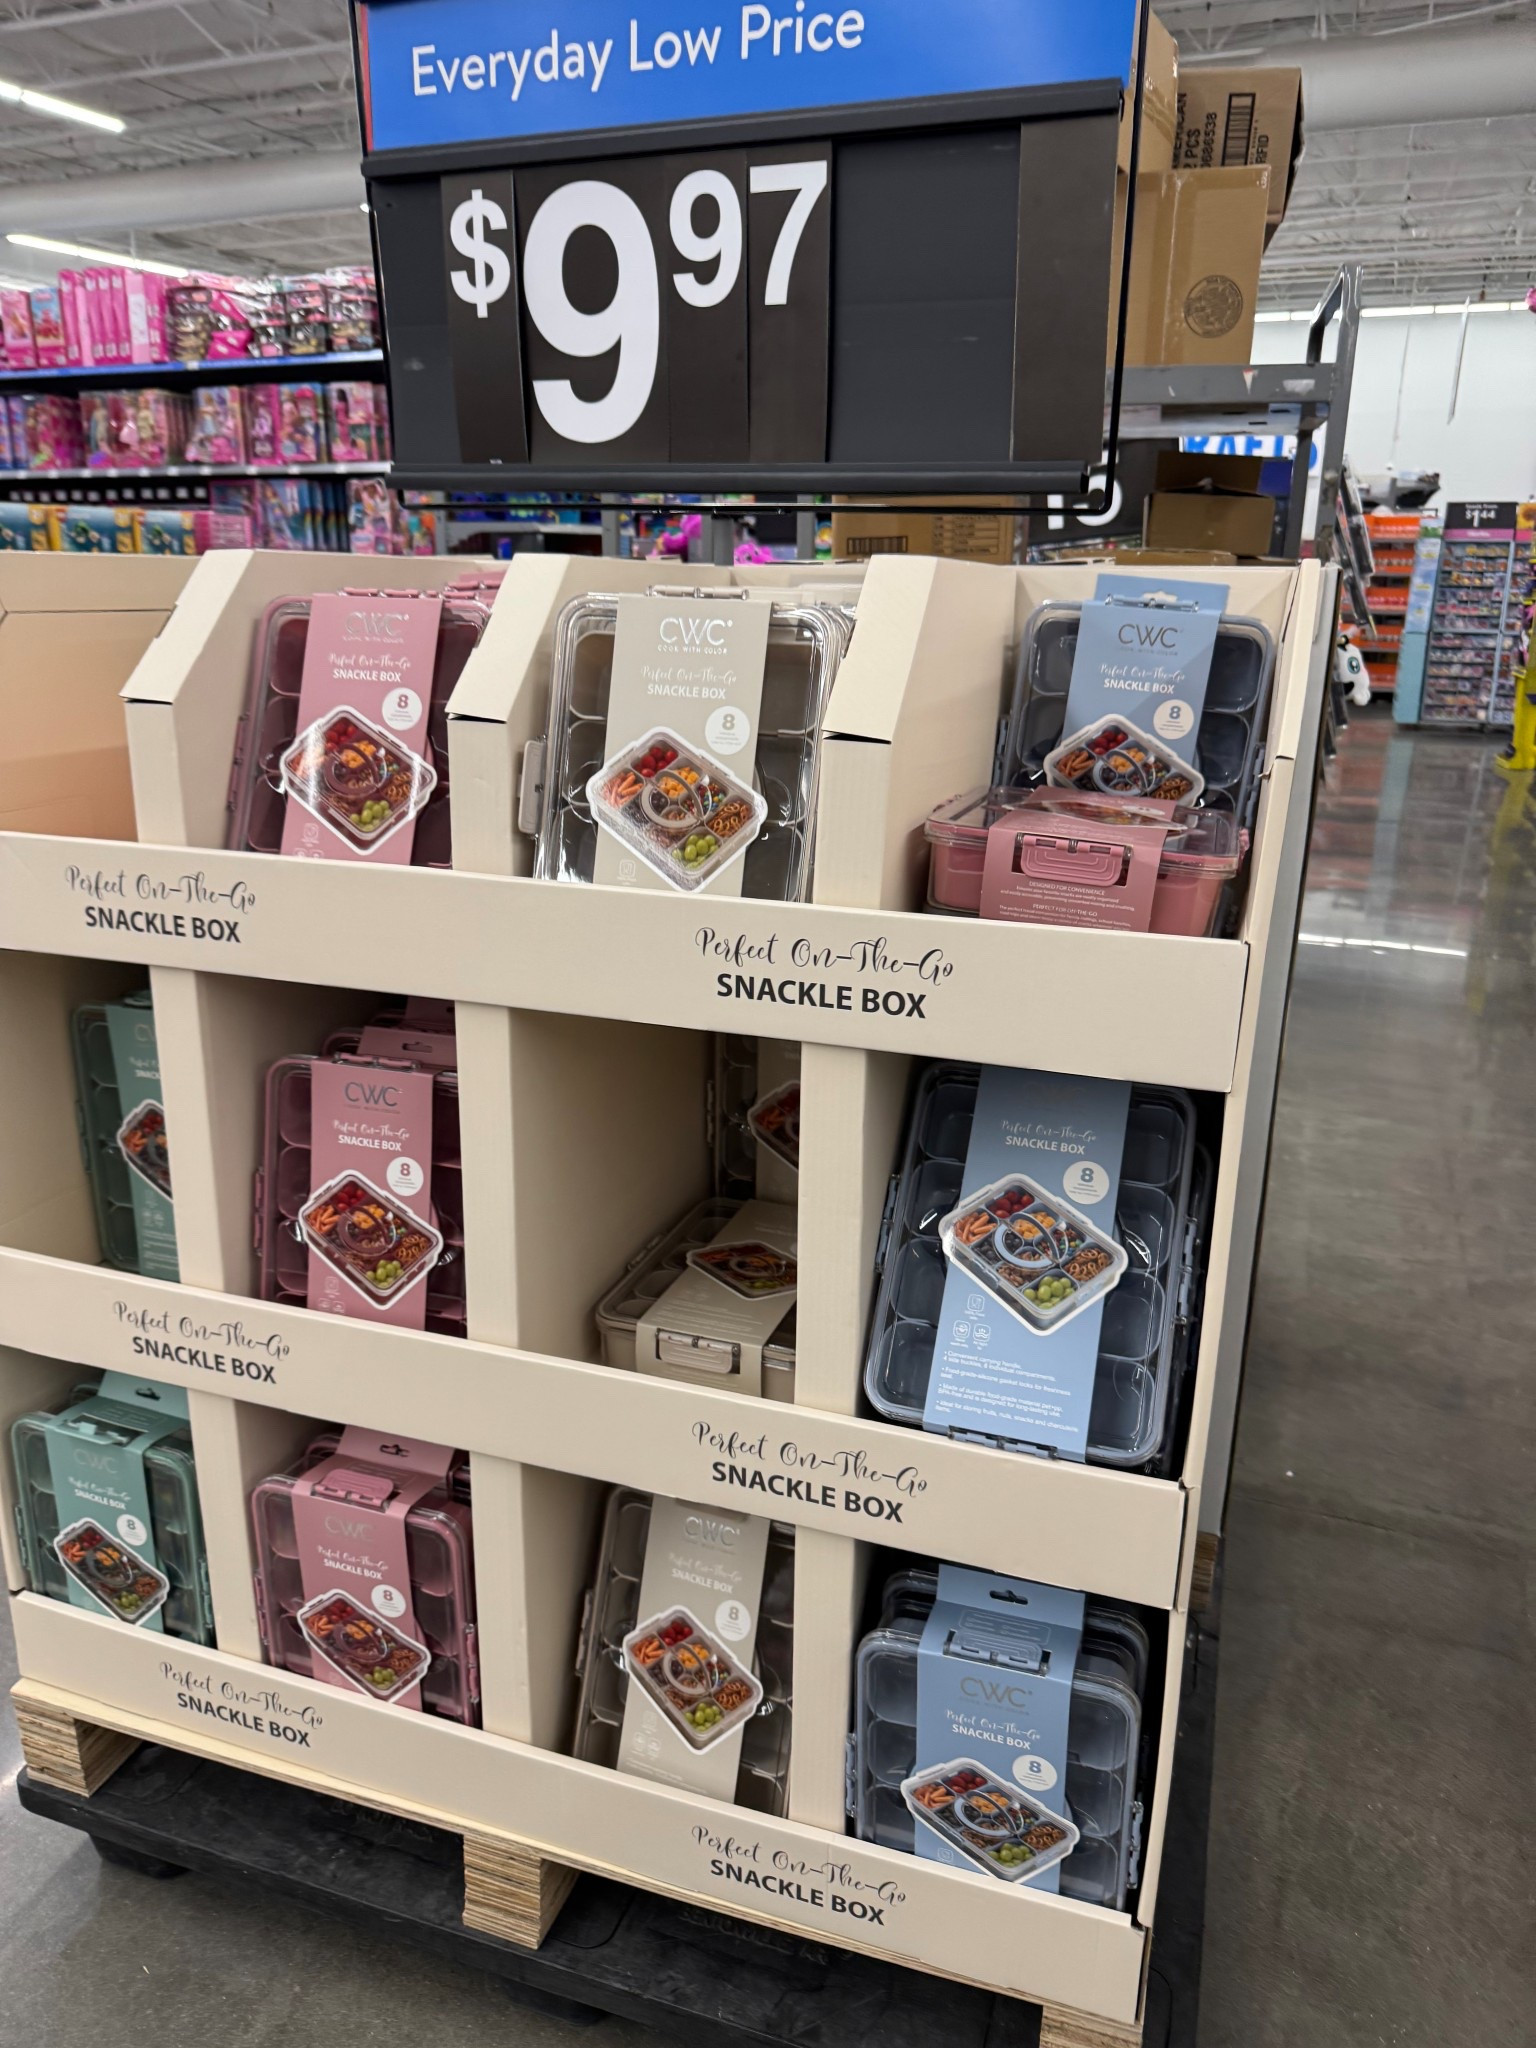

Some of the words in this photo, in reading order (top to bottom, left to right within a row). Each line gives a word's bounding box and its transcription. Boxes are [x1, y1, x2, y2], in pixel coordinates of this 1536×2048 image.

[412, 29, 613, 101] Everyday
[630, 19, 721, 71] Low
[741, 1, 865, 59] Price
[1185, 128, 1200, 159] PCS
[1255, 134, 1269, 165] RFID
[345, 611, 403, 636] CWC
[660, 617, 726, 645] CWC
[1118, 623, 1178, 648] CWC
[333, 668, 379, 681] SNACKLE
[380, 670, 401, 683] BOX
[1104, 678, 1150, 692] SNACKLE
[1152, 683, 1175, 694] BOX
[397, 694, 409, 709] 8
[647, 683, 700, 697] SNACKLE
[702, 687, 726, 699] BOX
[722, 713, 736, 731] 8
[1169, 706, 1181, 720] 8
[66, 865, 126, 900] Perfect
[137, 871, 256, 914] On-The-Go
[85, 906, 186, 937] SNACKLE
[191, 917, 241, 943] BOX
[695, 927, 778, 967] Perfect
[791, 937, 953, 986] On-The-Go
[717, 973, 852, 1011] SNACKLE
[861, 988, 926, 1019] BOX
[345, 1082, 398, 1107] CWC
[338, 1134, 380, 1149] SNACKLE
[381, 1140, 402, 1152] BOX
[1005, 1135, 1058, 1151] SNACKLE
[1060, 1142, 1086, 1155] BOX
[400, 1162, 410, 1177] 8
[1080, 1167, 1094, 1183] 8
[113, 1301, 171, 1333] Perfect
[179, 1316, 290, 1361] On-The-Go
[133, 1336, 226, 1373] SNACKLE
[232, 1358, 277, 1384] BOX
[692, 1421, 768, 1460] Perfect
[780, 1442, 927, 1498] On-The-Go
[712, 1461, 836, 1508] SNACKLE
[844, 1491, 903, 1524] BOX
[323, 1558, 362, 1575] SNACKLE
[363, 1568, 382, 1580] BOX
[383, 1590, 393, 1601] 8
[729, 1607, 739, 1620] 8
[160, 1662, 212, 1694] Perfect
[221, 1681, 323, 1729] On-The-Go
[961, 1676, 1026, 1708] CWC
[177, 1693, 264, 1733] SNACKLE
[269, 1721, 311, 1748] BOX
[952, 1724, 1004, 1744] SNACKLE
[1006, 1738, 1031, 1750] BOX
[1029, 1760, 1041, 1773] 8
[691, 1825, 761, 1862] Perfect
[773, 1850, 906, 1907] On-The-Go
[710, 1859, 824, 1908] SNACKLE
[831, 1894, 885, 1926] BOX
